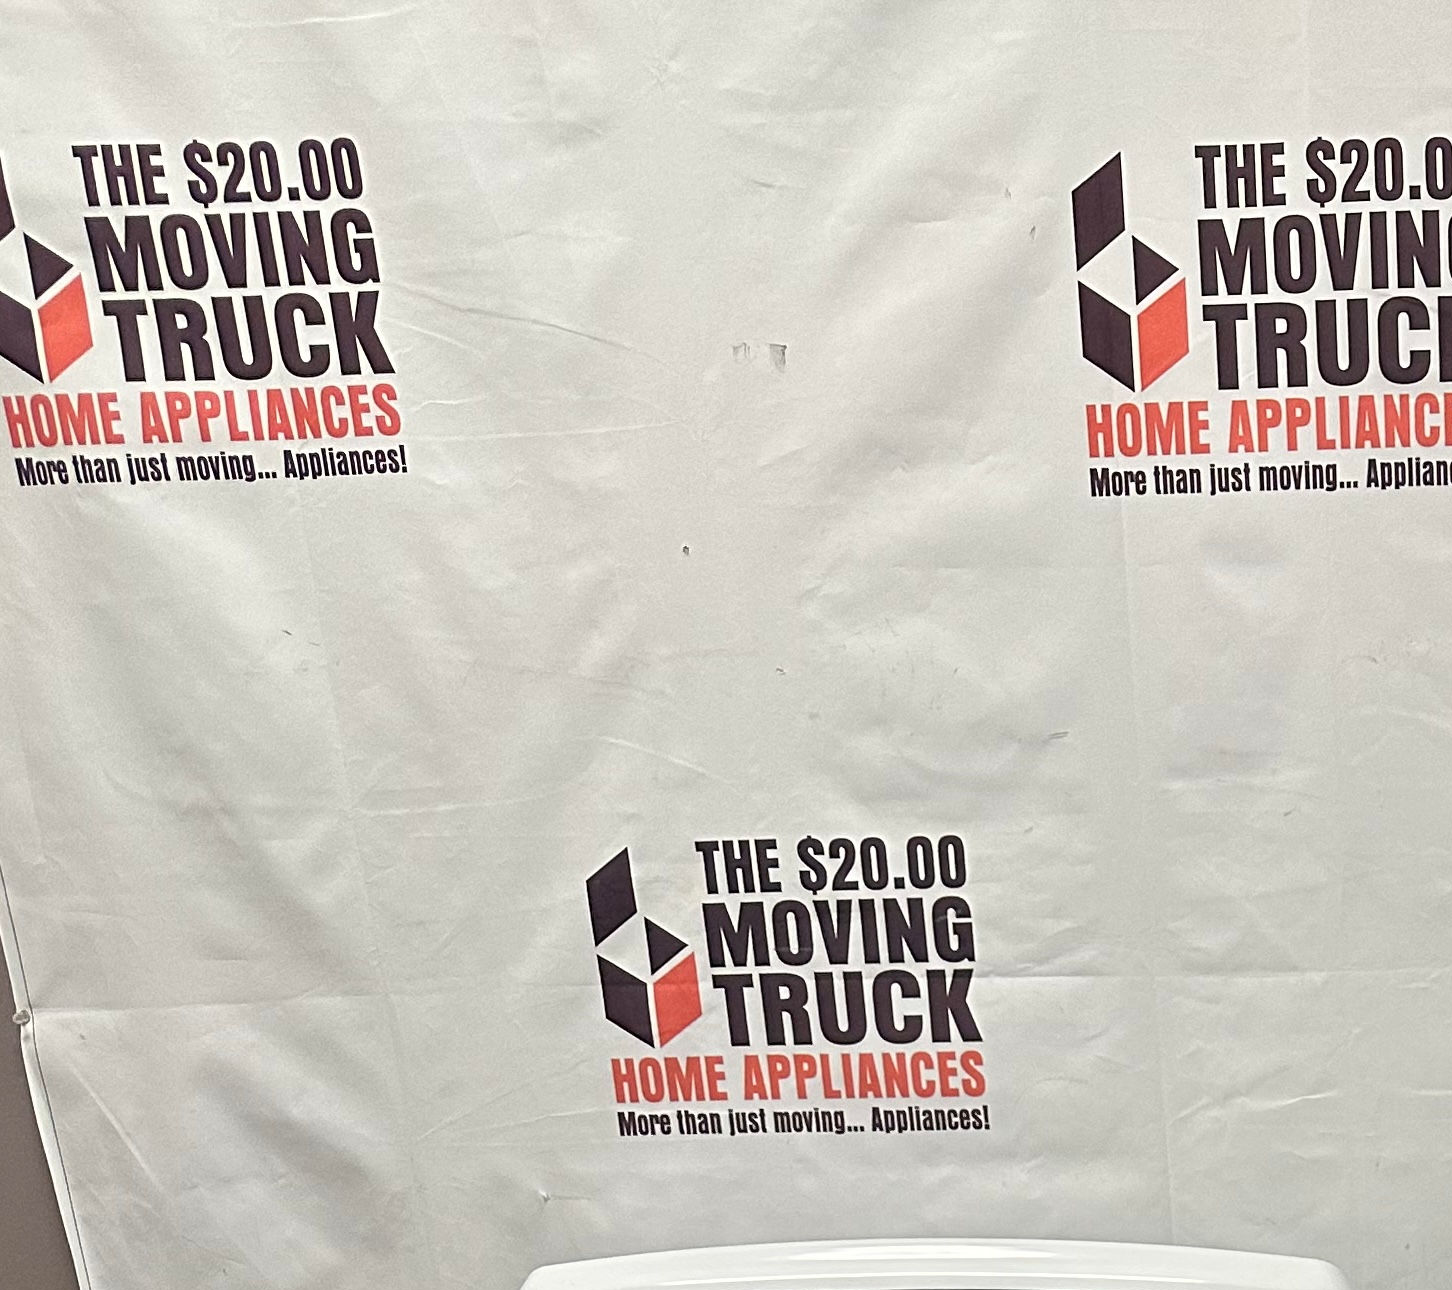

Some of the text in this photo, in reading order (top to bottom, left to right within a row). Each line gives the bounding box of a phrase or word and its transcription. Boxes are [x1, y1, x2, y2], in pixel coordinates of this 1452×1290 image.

[72, 138, 362, 208] THE $20.00
[1195, 142, 1286, 209] THE
[84, 208, 380, 292] MOVING
[102, 291, 395, 382] TRUCK
[3, 384, 401, 448] HOME APPLIANCES
[1086, 400, 1211, 458] HOME
[15, 445, 407, 486] More than just moving... Appliances!
[1090, 468, 1146, 496] More
[1154, 466, 1201, 494] than
[1210, 463, 1251, 495] just
[1259, 461, 1358, 491] moving...
[695, 835, 966, 895] THE $20.00
[702, 896, 975, 968] MOVING
[712, 969, 982, 1046] TRUCK
[611, 1050, 986, 1104] HOME APPLIANCES
[618, 1105, 990, 1136] More than just moving... Appliances!
